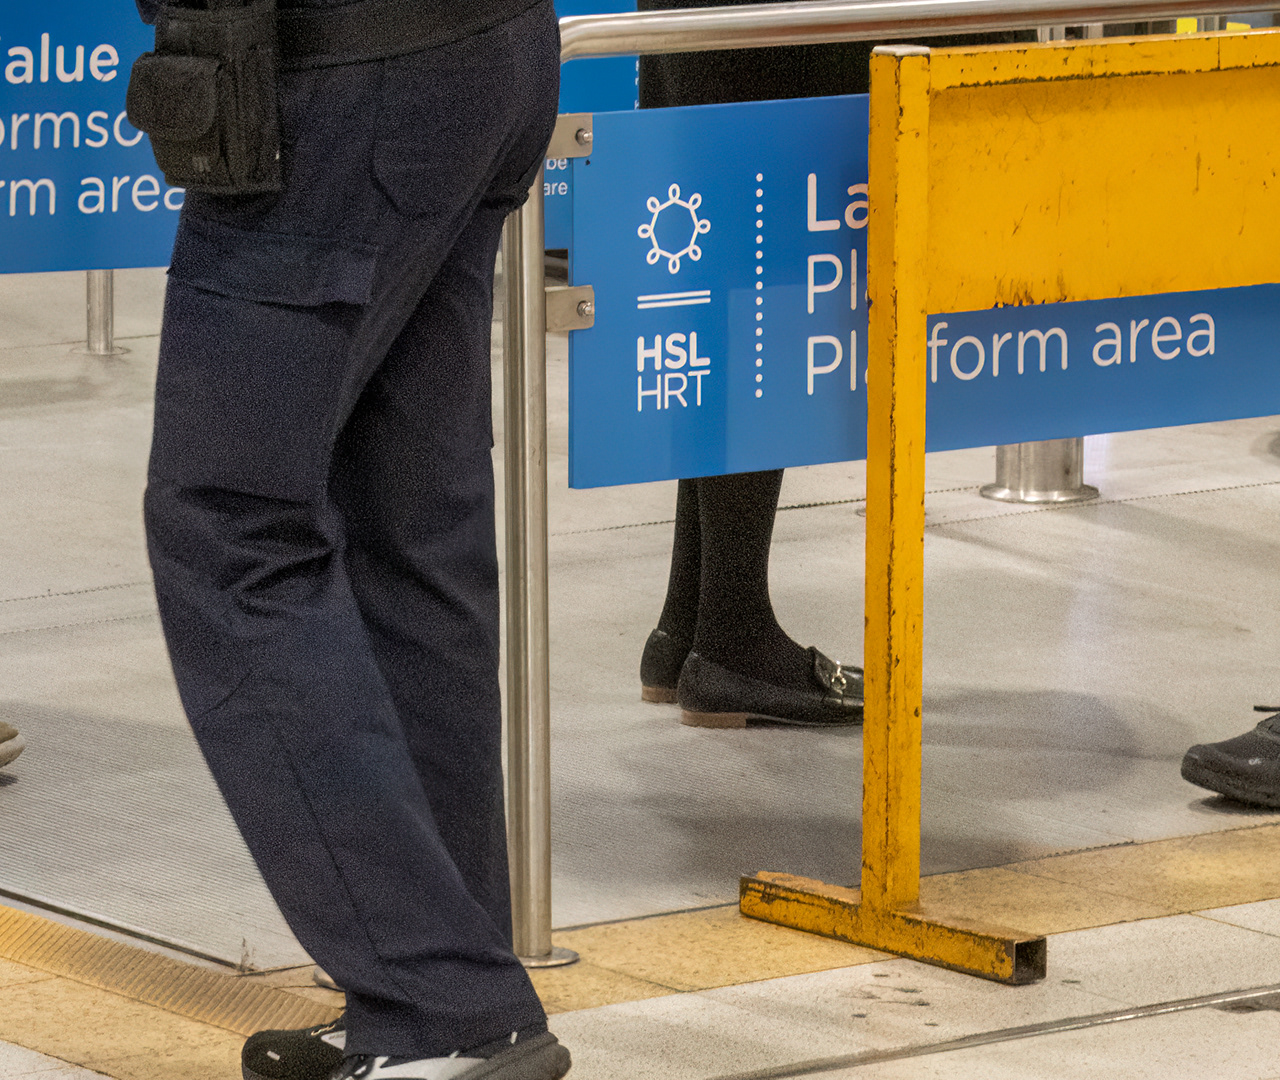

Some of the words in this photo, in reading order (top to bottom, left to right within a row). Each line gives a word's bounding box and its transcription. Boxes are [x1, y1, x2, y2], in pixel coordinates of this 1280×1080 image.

[637, 331, 711, 372] HSL
[1092, 312, 1215, 367] area
[637, 369, 711, 412] HRT
